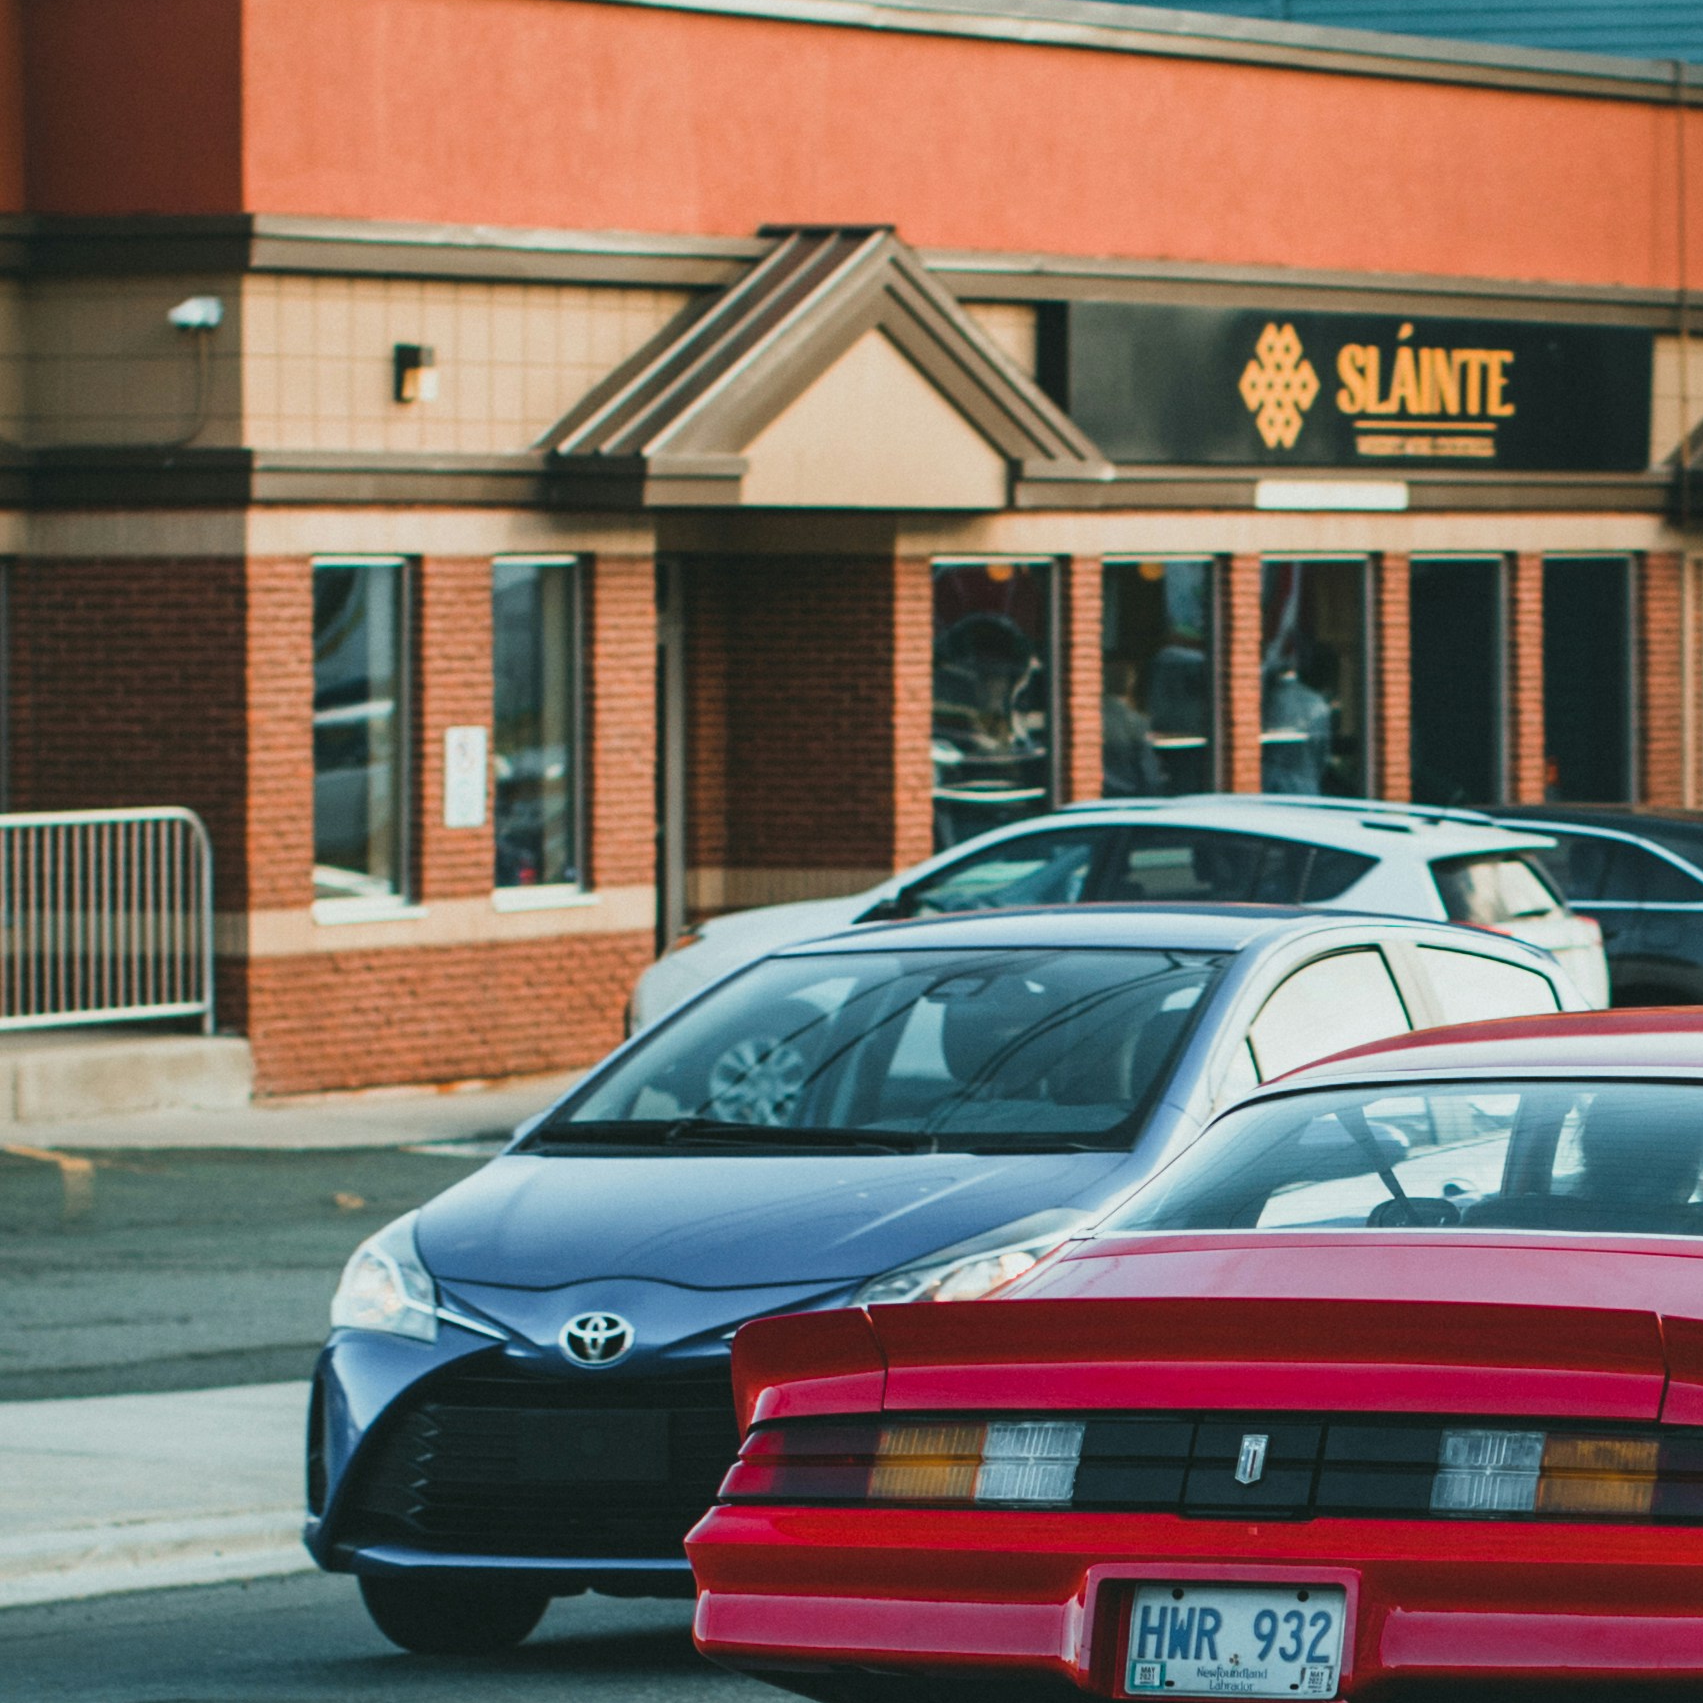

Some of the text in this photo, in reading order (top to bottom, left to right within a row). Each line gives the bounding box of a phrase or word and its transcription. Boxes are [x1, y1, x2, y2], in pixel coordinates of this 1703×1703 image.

[1336, 322, 1515, 416] SLÁINTE
[1137, 1605, 1332, 1664] HWR 932
[1196, 1664, 1268, 1681] Newfoundland
[1209, 1679, 1253, 1692] Labrador
